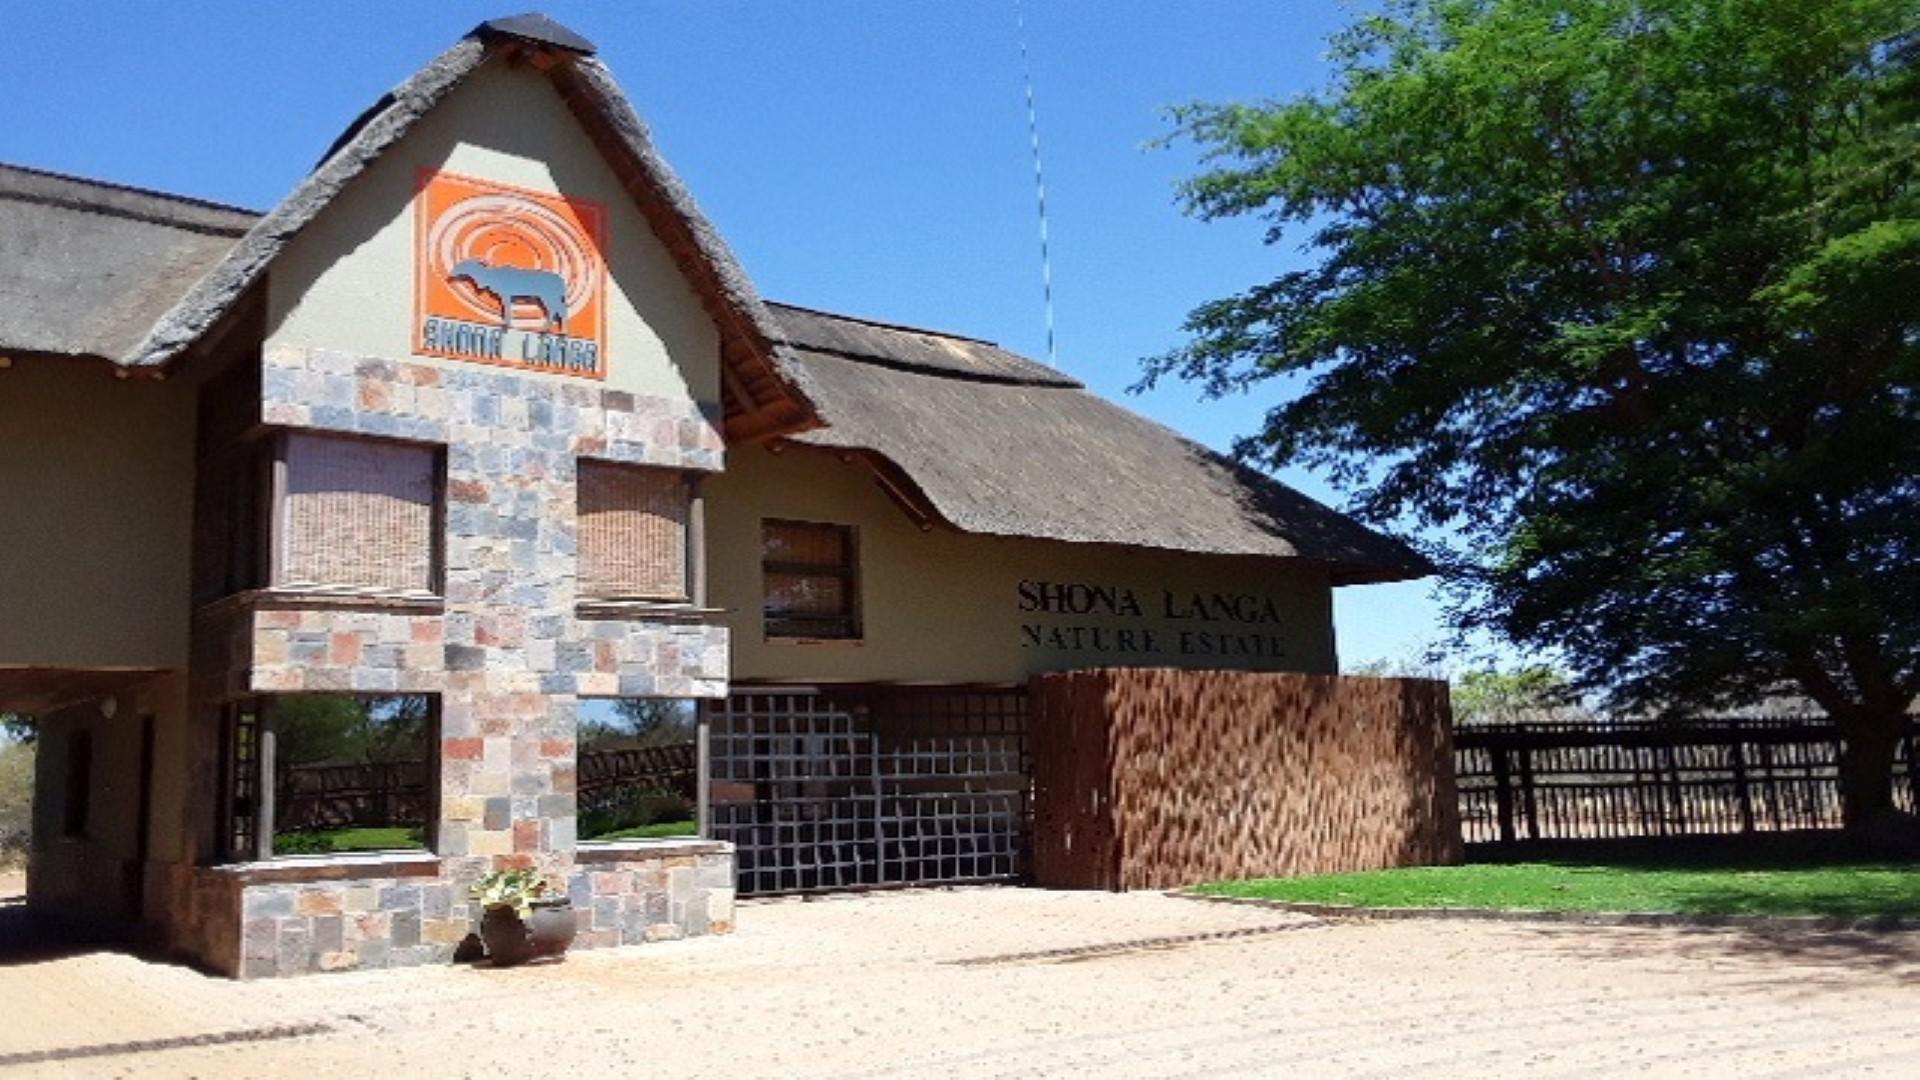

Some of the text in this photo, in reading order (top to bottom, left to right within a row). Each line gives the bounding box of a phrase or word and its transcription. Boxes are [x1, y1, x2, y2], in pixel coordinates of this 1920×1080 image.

[1017, 579, 1280, 624] SHONA LANGA
[1021, 624, 1286, 657] NATURE ESTATE
